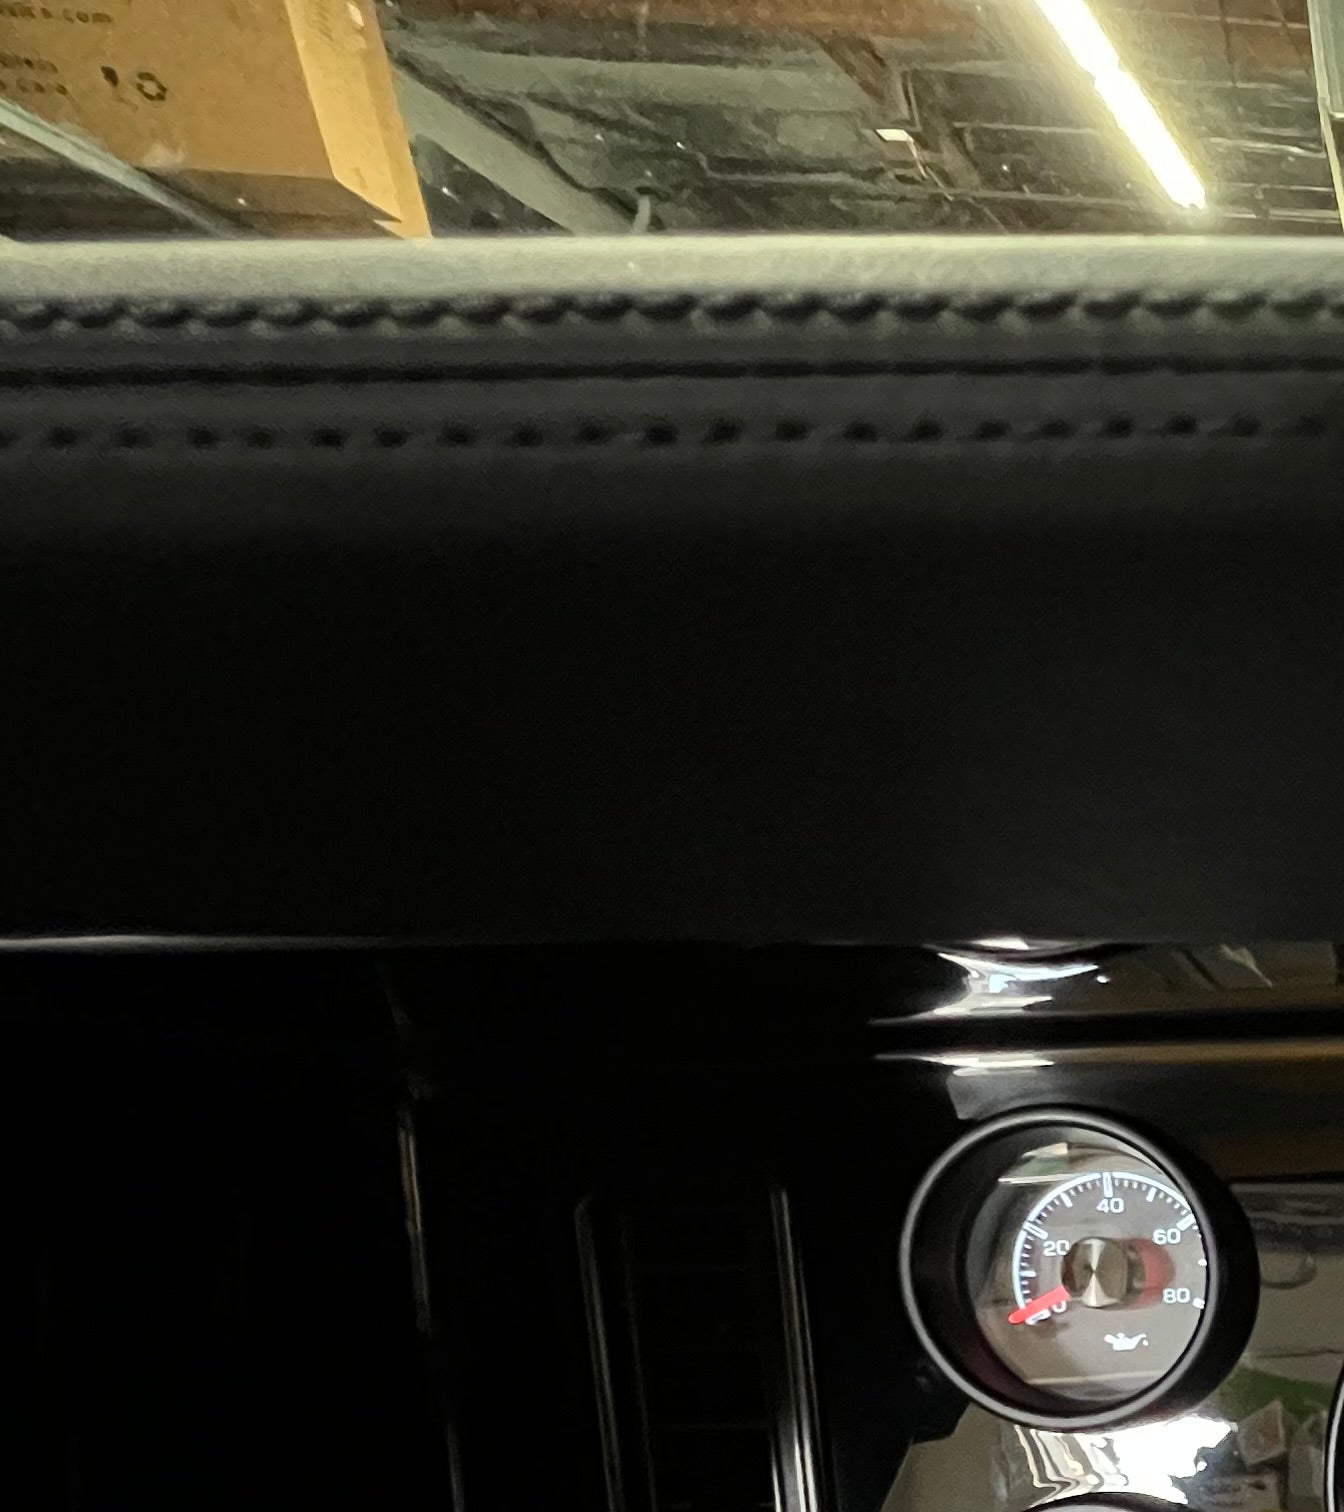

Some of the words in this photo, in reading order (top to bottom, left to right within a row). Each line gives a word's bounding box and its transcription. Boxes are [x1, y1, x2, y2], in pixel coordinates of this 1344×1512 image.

[1097, 1199, 1125, 1213] 40
[1152, 1229, 1181, 1244] 60
[1042, 1240, 1070, 1256] 20
[1163, 1289, 1191, 1303] 80
